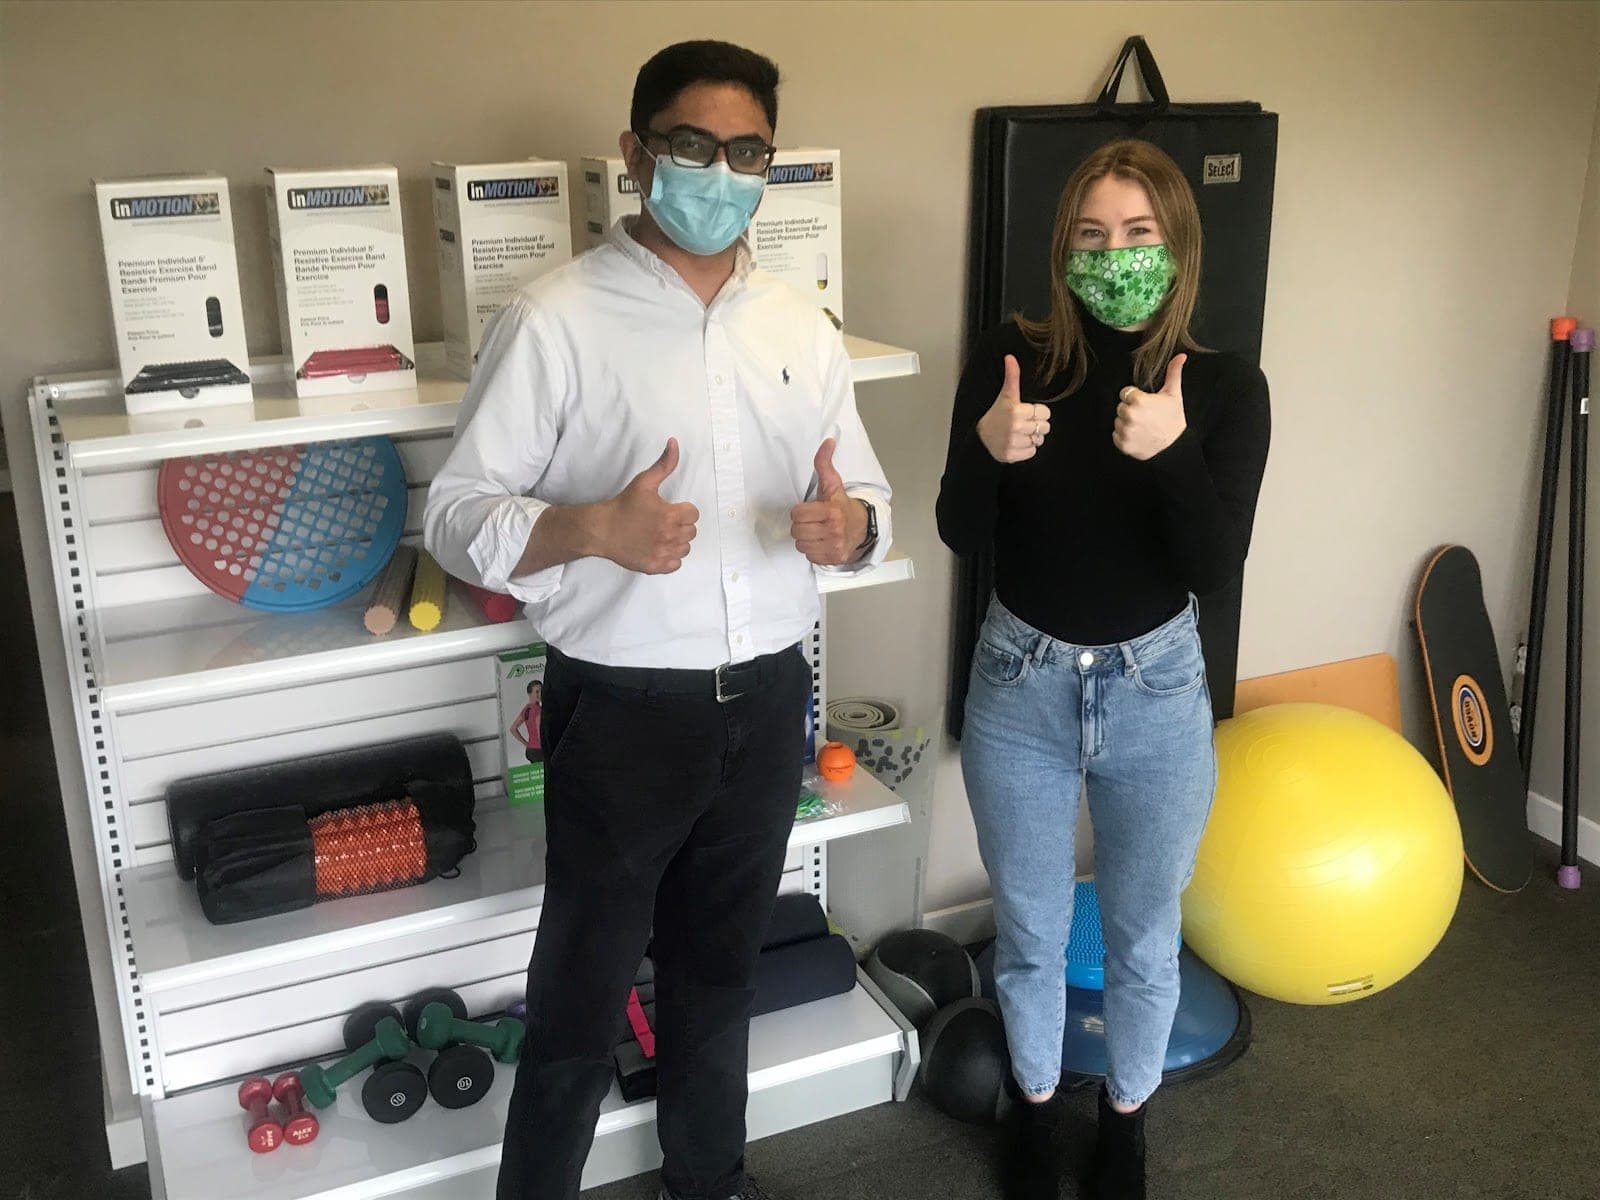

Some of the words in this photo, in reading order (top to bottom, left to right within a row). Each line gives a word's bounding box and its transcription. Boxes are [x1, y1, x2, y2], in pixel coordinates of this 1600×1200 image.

[769, 166, 814, 182] MOTION
[1208, 160, 1235, 177] SELECT
[471, 180, 537, 199] inMOTION
[292, 188, 366, 208] inMOTION
[115, 197, 193, 218] inMOTION
[294, 248, 328, 256] Premium
[330, 245, 366, 254] Individual
[537, 242, 554, 250] Band
[118, 259, 156, 268] Premium
[157, 256, 196, 265] Individual
[294, 257, 329, 265] Resistive
[331, 255, 363, 263] Exercise
[120, 268, 157, 276] Resistive
[159, 266, 194, 274] Exercise
[196, 264, 217, 272] Band
[295, 265, 320, 273] Bande
[322, 263, 356, 271] Premium
[120, 277, 147, 285] Bande
[149, 274, 186, 282] Premium
